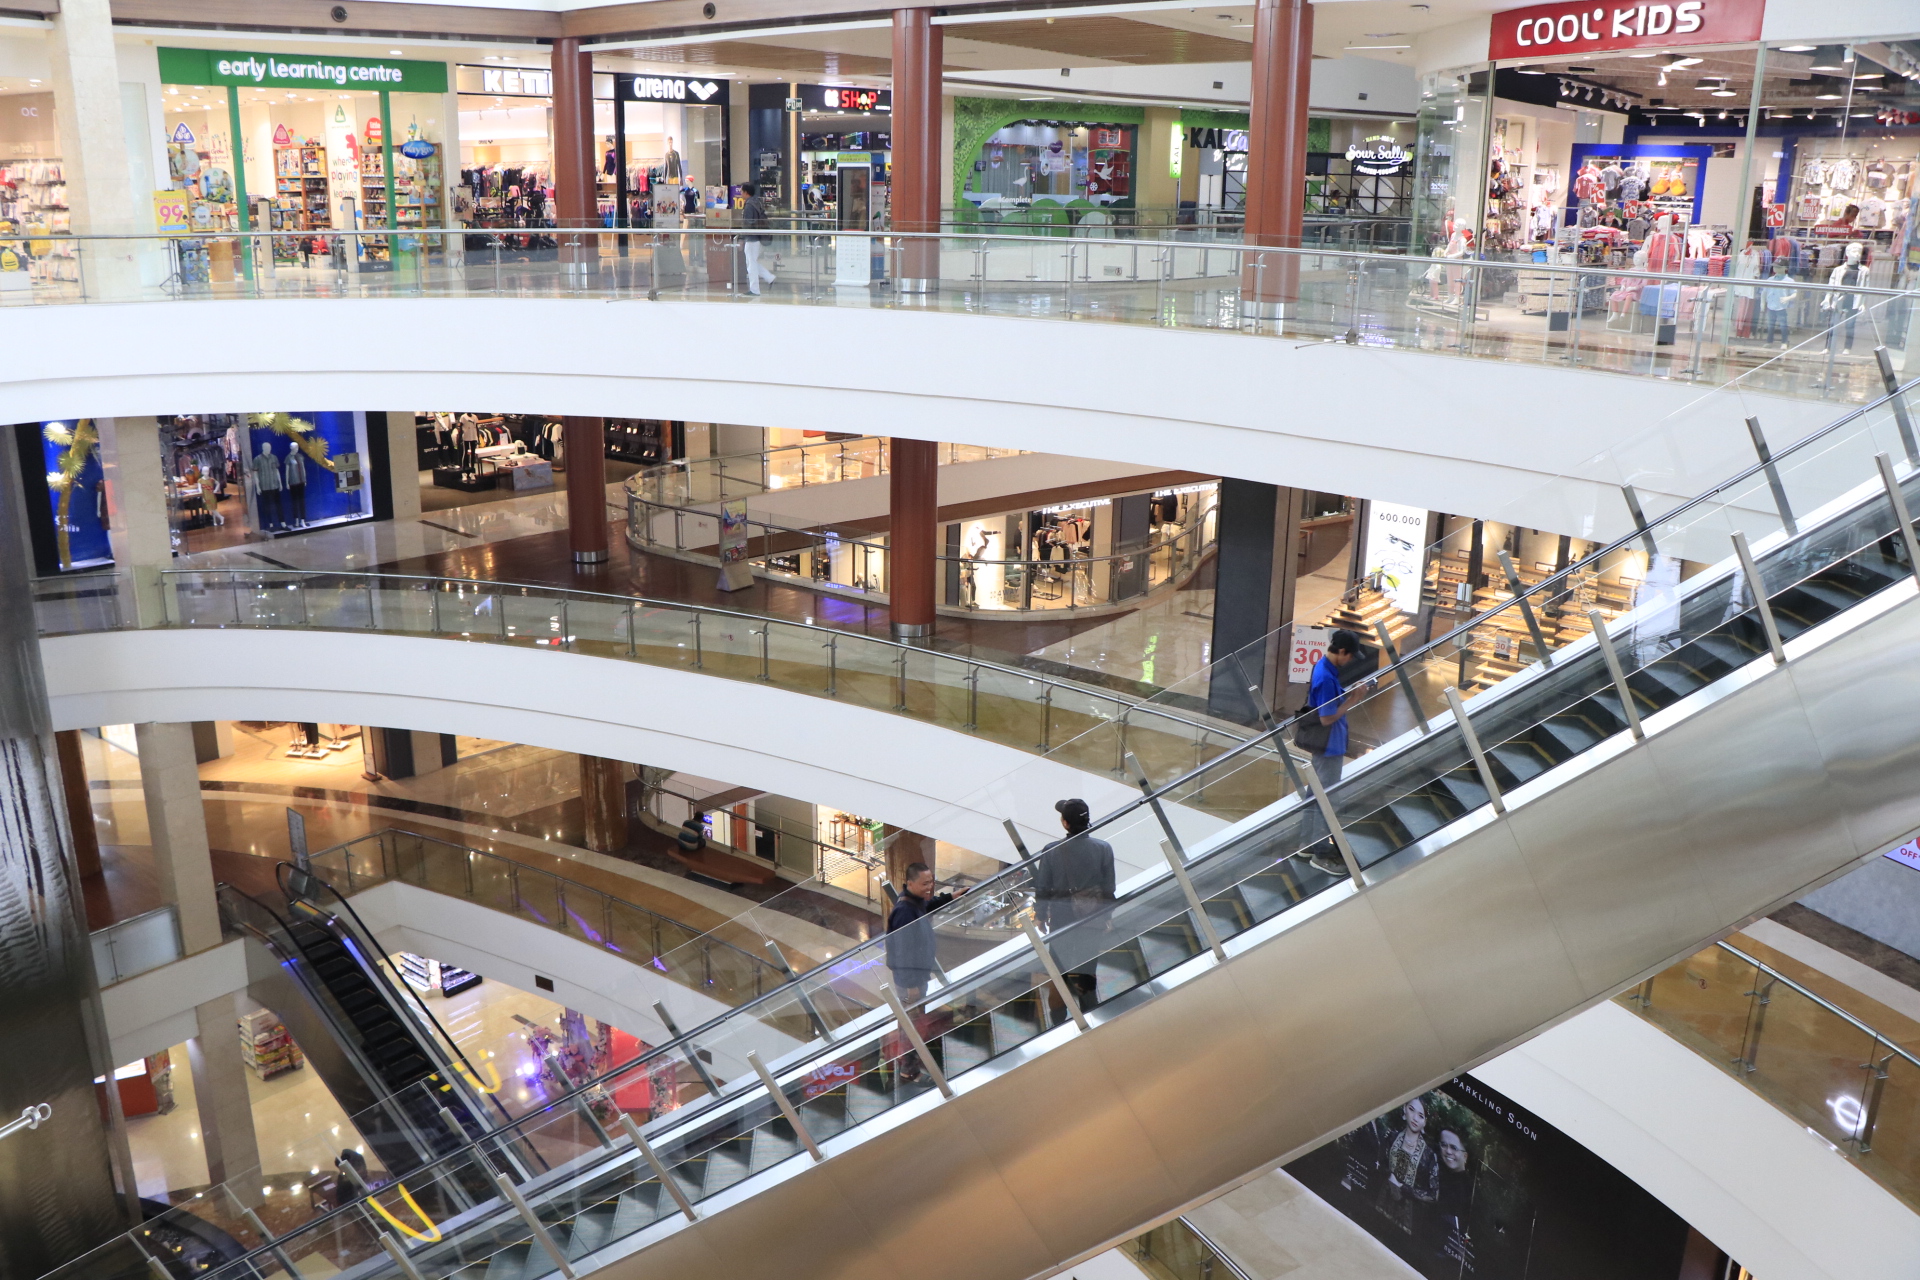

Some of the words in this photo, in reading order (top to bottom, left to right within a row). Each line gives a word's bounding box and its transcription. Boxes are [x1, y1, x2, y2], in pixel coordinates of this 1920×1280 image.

[1516, 8, 1603, 46] COOL
[1611, 1, 1702, 38] KIDS
[217, 56, 267, 82] early
[269, 58, 347, 84] learning
[349, 64, 403, 83] centre
[634, 77, 686, 99] arena
[1348, 144, 1377, 160] Sour
[1377, 145, 1409, 163] Sally
[331, 168, 358, 183] playing
[1590, 190, 1605, 204] 70
[159, 205, 184, 224] 99
[1623, 205, 1637, 218] 70
[1766, 212, 1784, 226] 70
[1173, 483, 1219, 496] EXECUTIVE
[1061, 498, 1112, 511] EXECUTIVE
[1379, 512, 1421, 526] 600.000
[1293, 647, 1323, 666] 30
